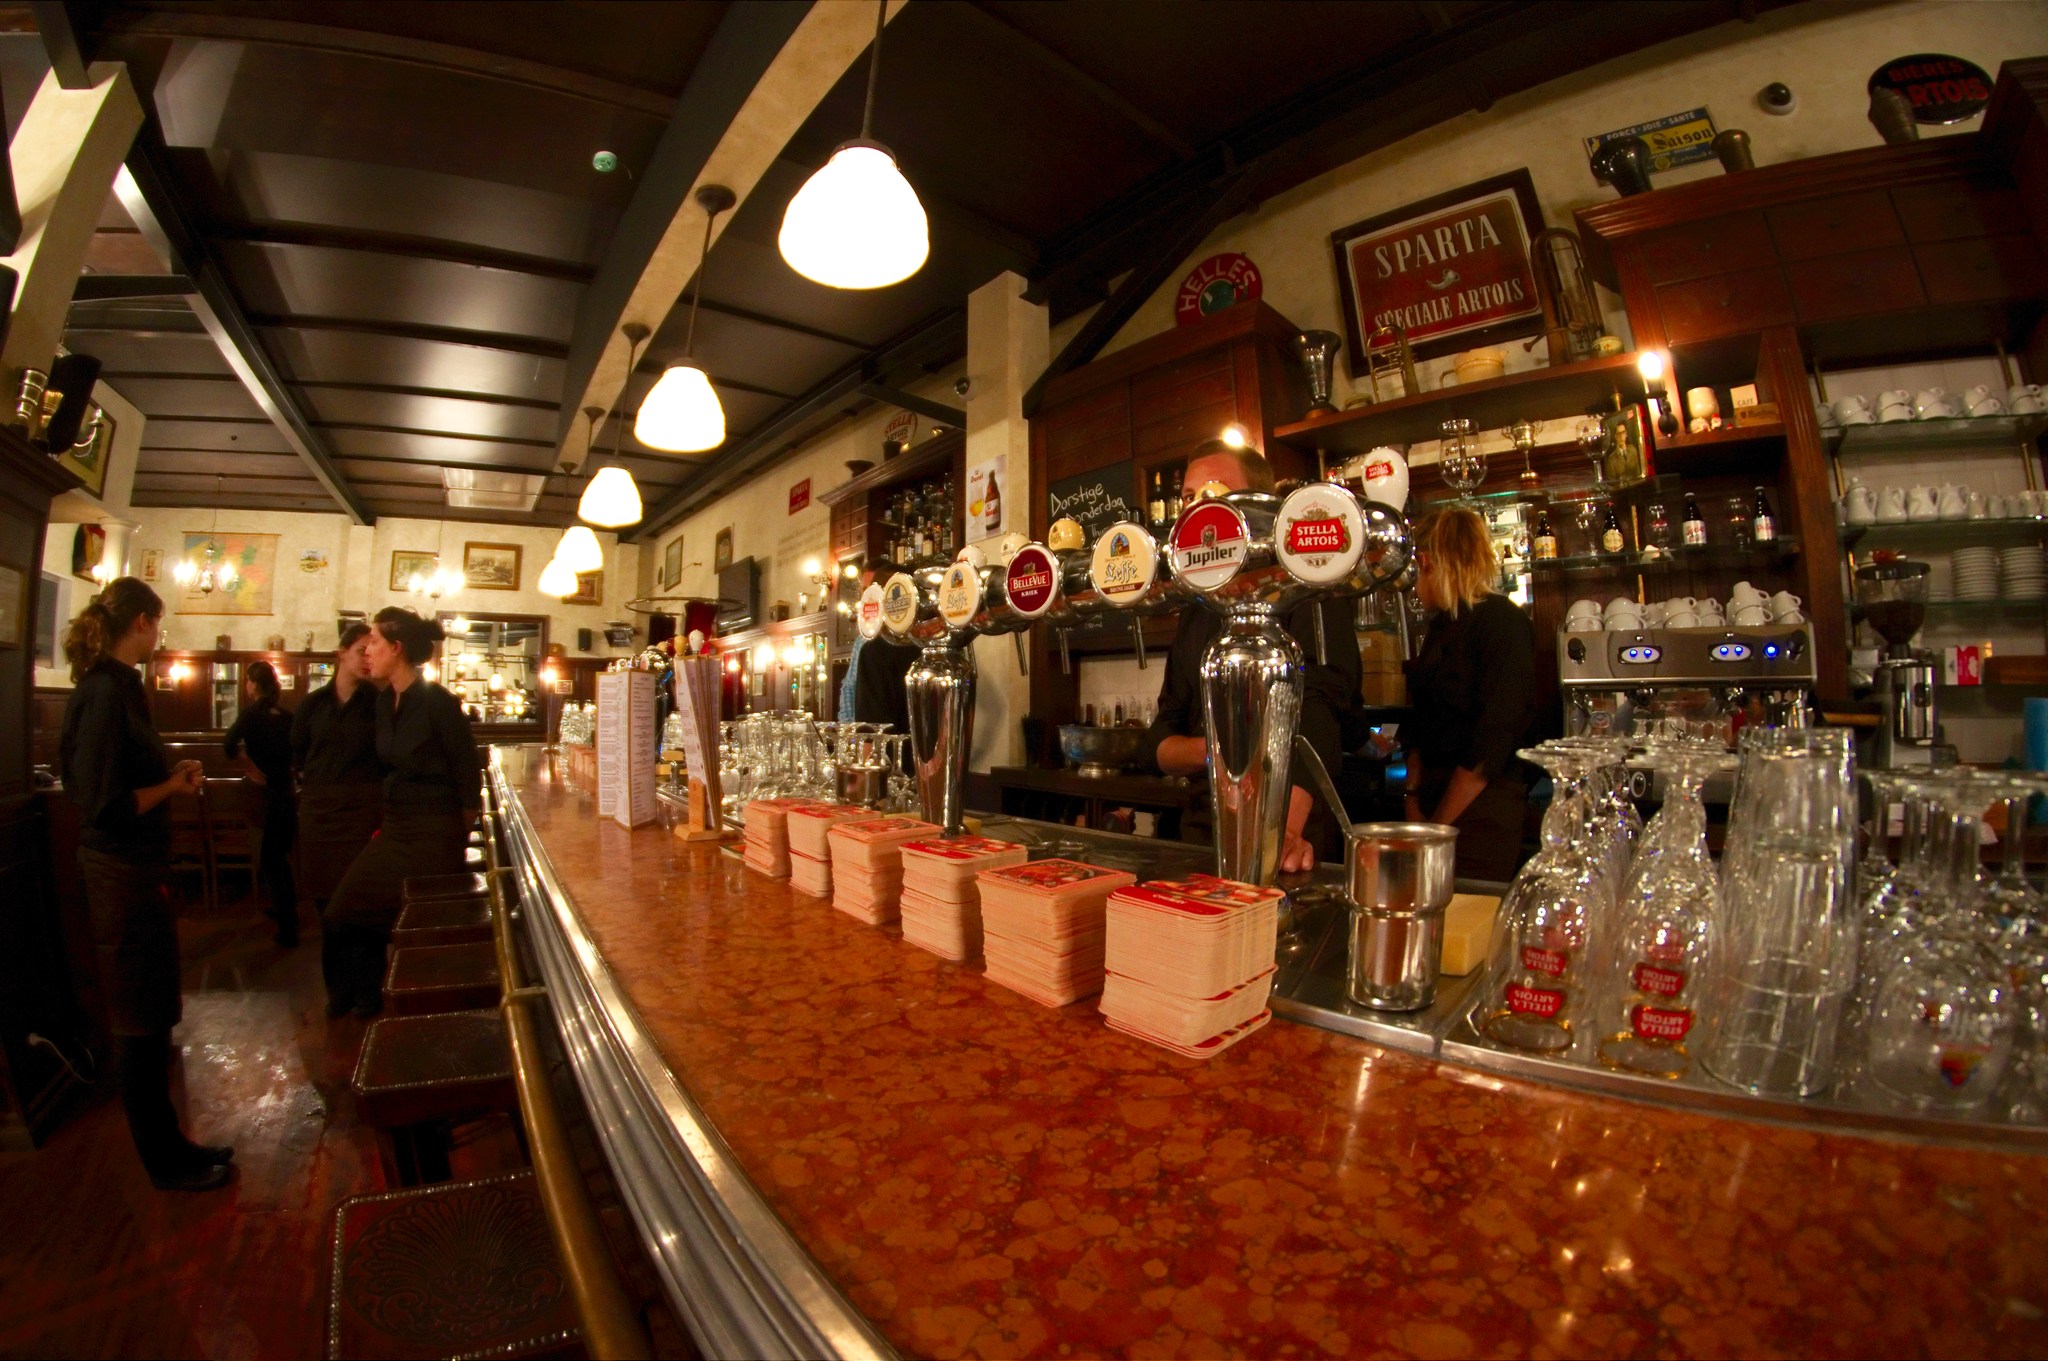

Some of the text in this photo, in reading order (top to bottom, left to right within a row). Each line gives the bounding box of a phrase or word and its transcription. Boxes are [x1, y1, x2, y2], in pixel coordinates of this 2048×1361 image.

[1892, 77, 1989, 107] RTOIS
[1652, 128, 1714, 150] Saison
[1375, 214, 1502, 279] SPARTA
[1457, 278, 1524, 316] ARTOIS
[1050, 483, 1104, 517] Dorstige
[1297, 524, 1337, 536] STELLA
[1297, 535, 1339, 547] ARTOIS
[1184, 545, 1237, 568] Jupiler
[1104, 559, 1139, 584] Leffe
[1513, 998, 1554, 1012] STELLA
[1514, 989, 1555, 1004] ARTOIS
[1640, 1021, 1683, 1035] STELLA
[1642, 1012, 1685, 1026] ARTOIS
